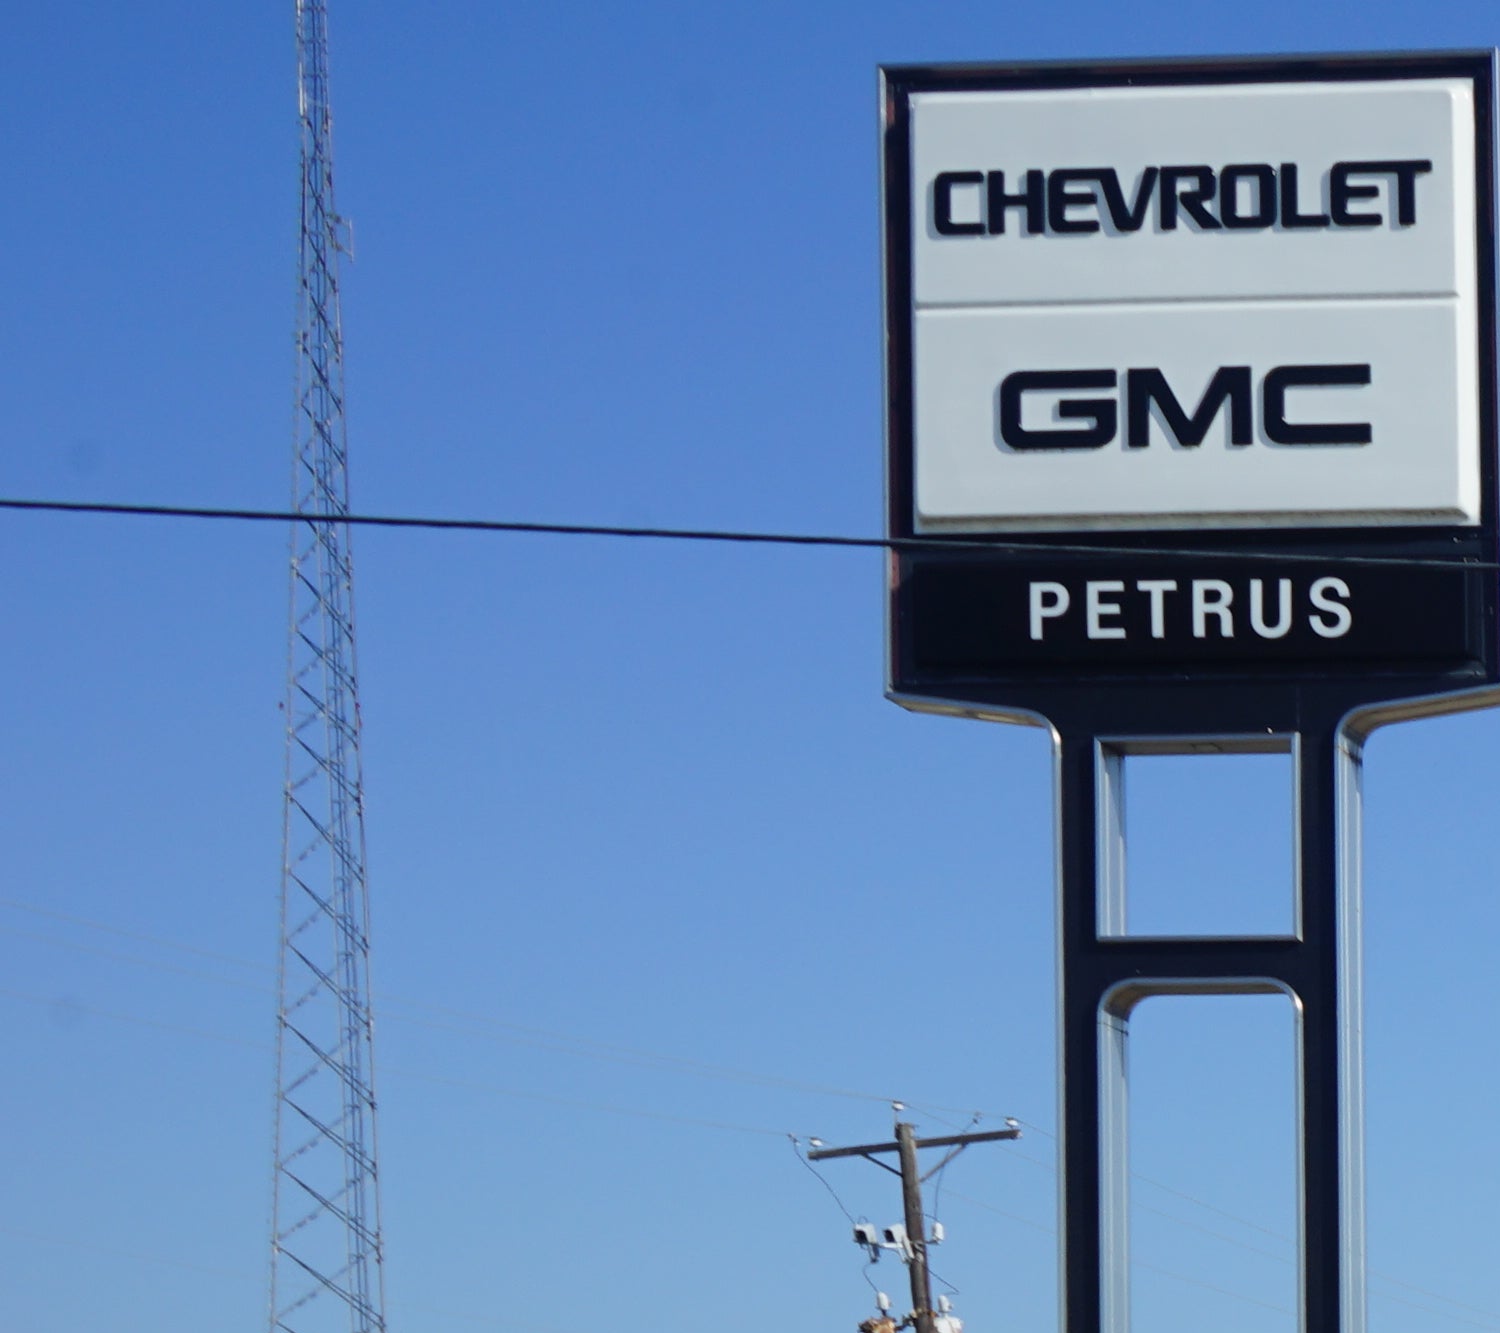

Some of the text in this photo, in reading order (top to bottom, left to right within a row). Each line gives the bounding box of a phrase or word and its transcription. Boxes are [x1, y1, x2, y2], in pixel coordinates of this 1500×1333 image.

[932, 160, 1433, 238] CHEVROLET
[999, 363, 1373, 450] GMC
[1028, 577, 1354, 641] PETRUS
